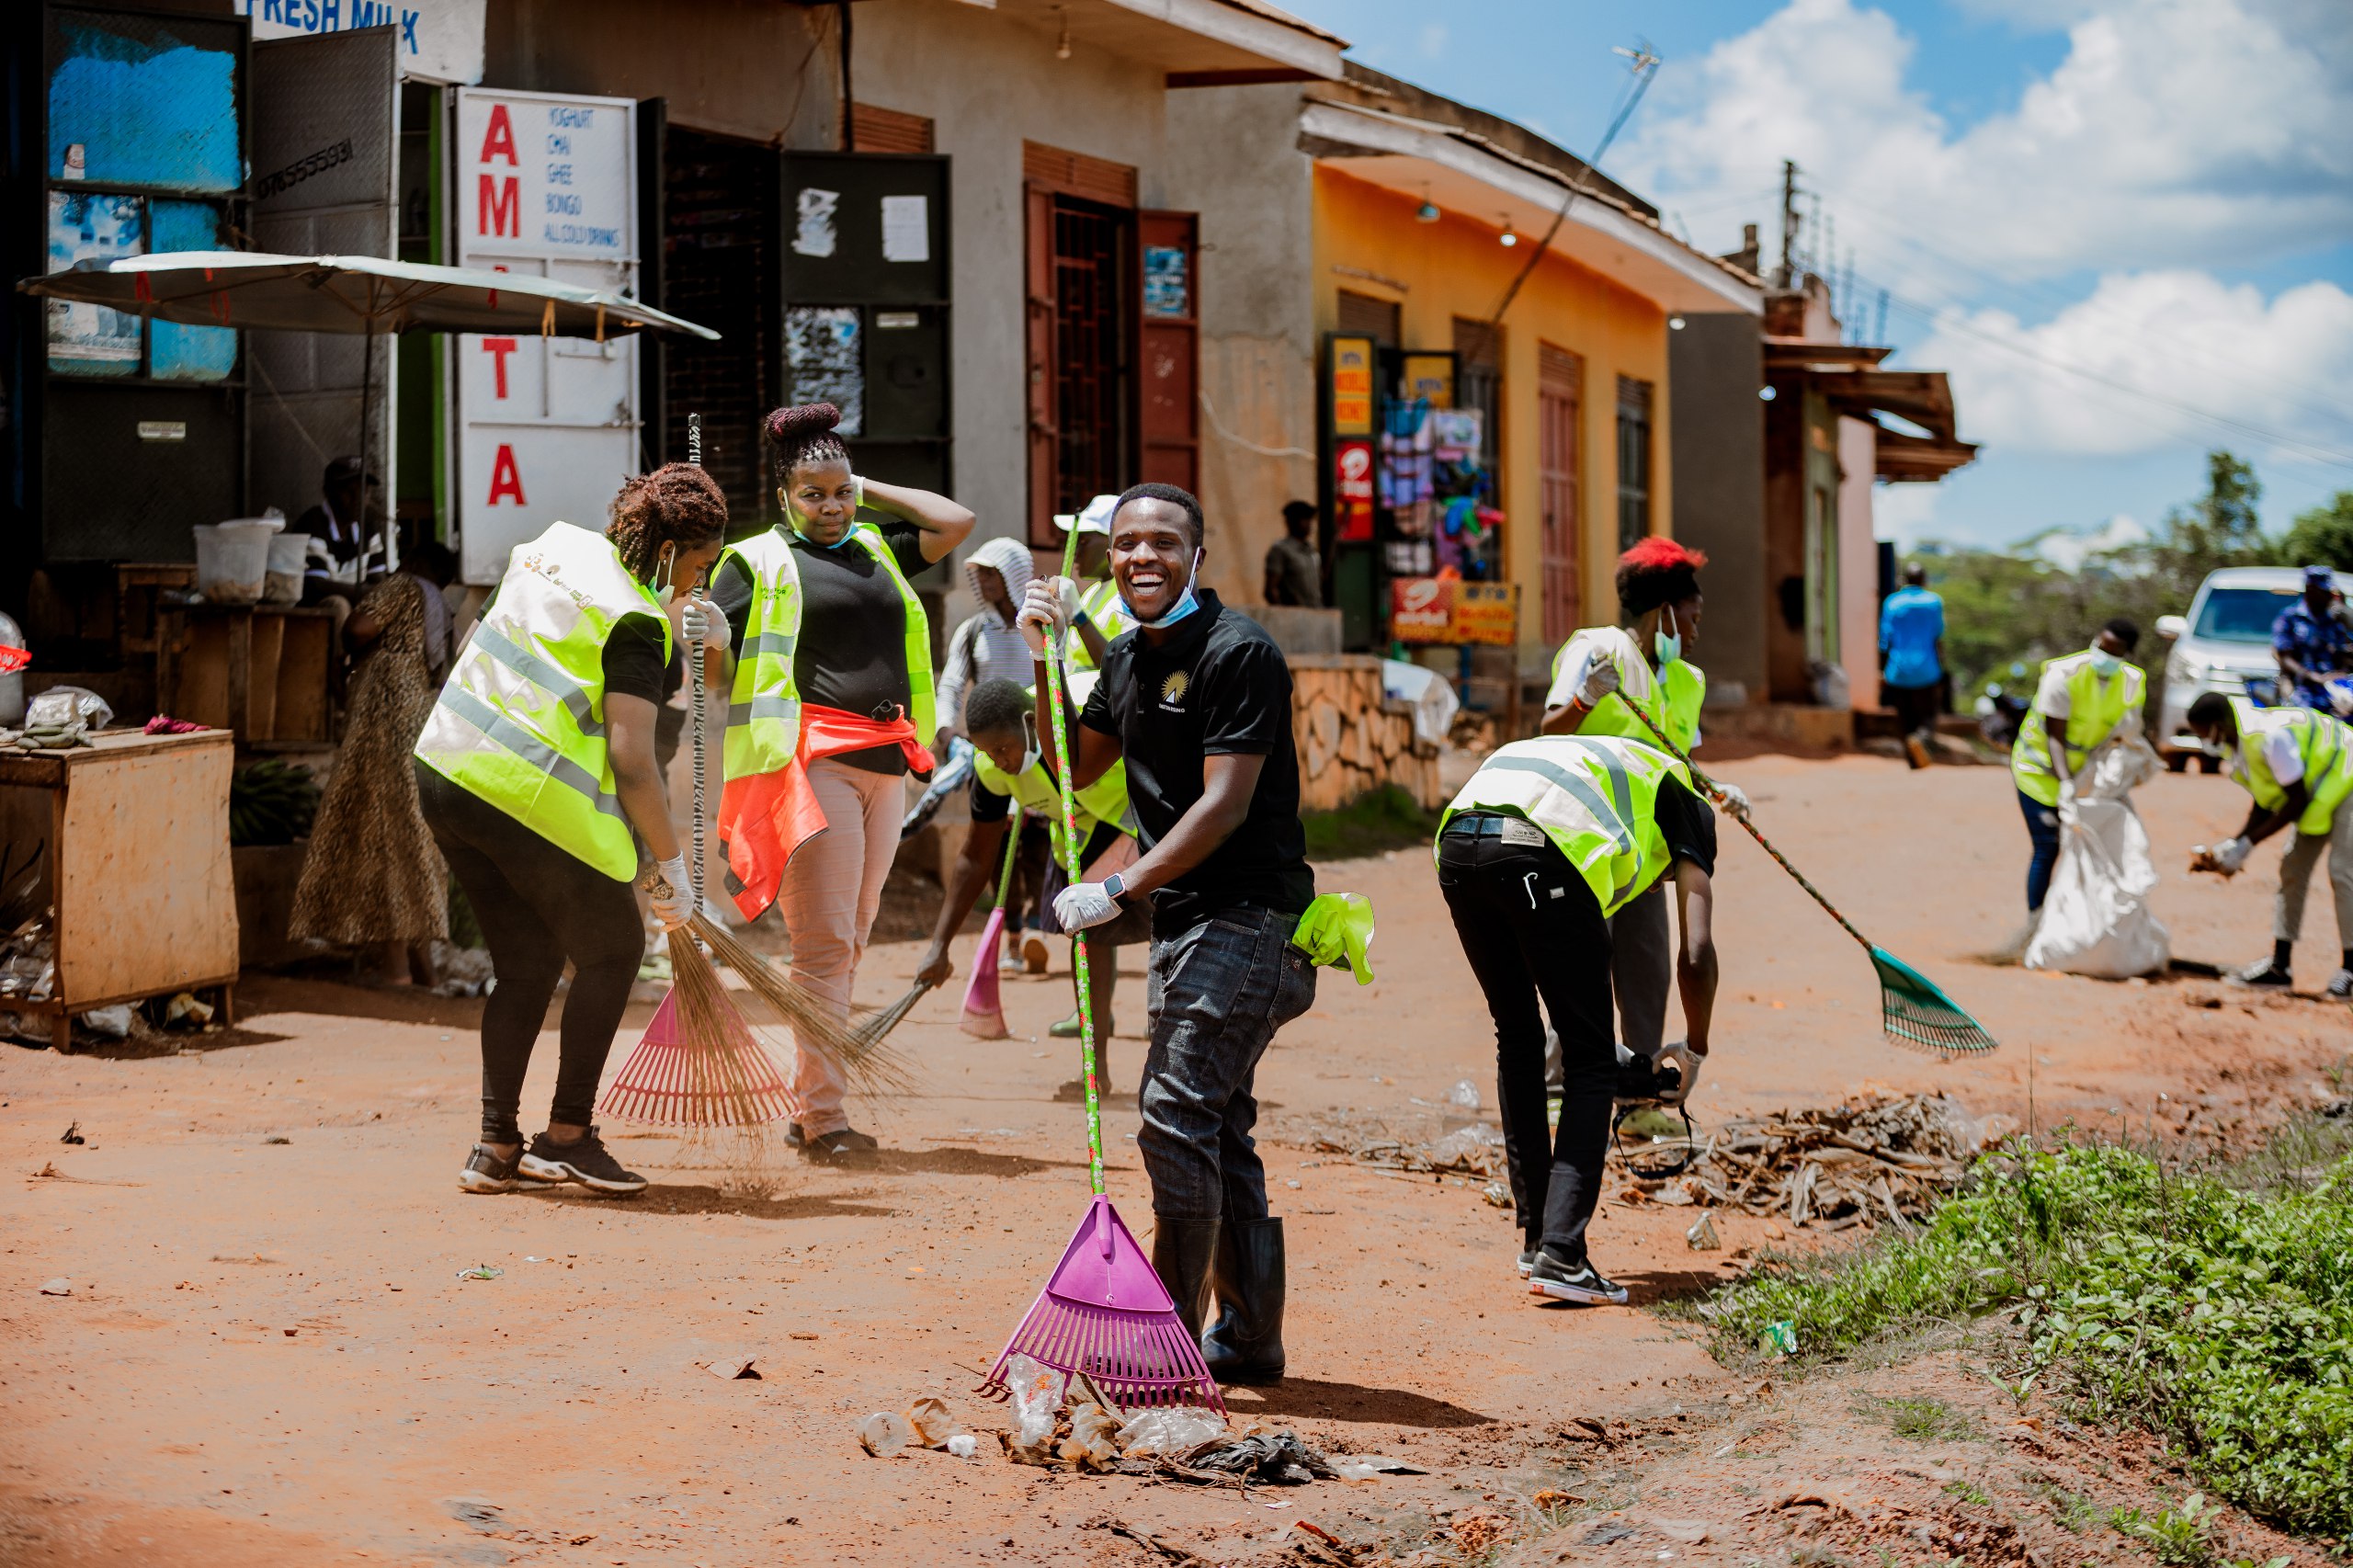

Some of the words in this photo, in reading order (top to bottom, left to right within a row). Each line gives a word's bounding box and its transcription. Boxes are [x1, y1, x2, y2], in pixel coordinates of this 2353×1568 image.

[549, 108, 594, 129] YOGHURT
[547, 133, 571, 155] CHAI
[547, 163, 573, 185] GHEE
[545, 193, 582, 216] BONGO
[562, 224, 586, 245] COLD
[479, 103, 528, 506] AMTA
